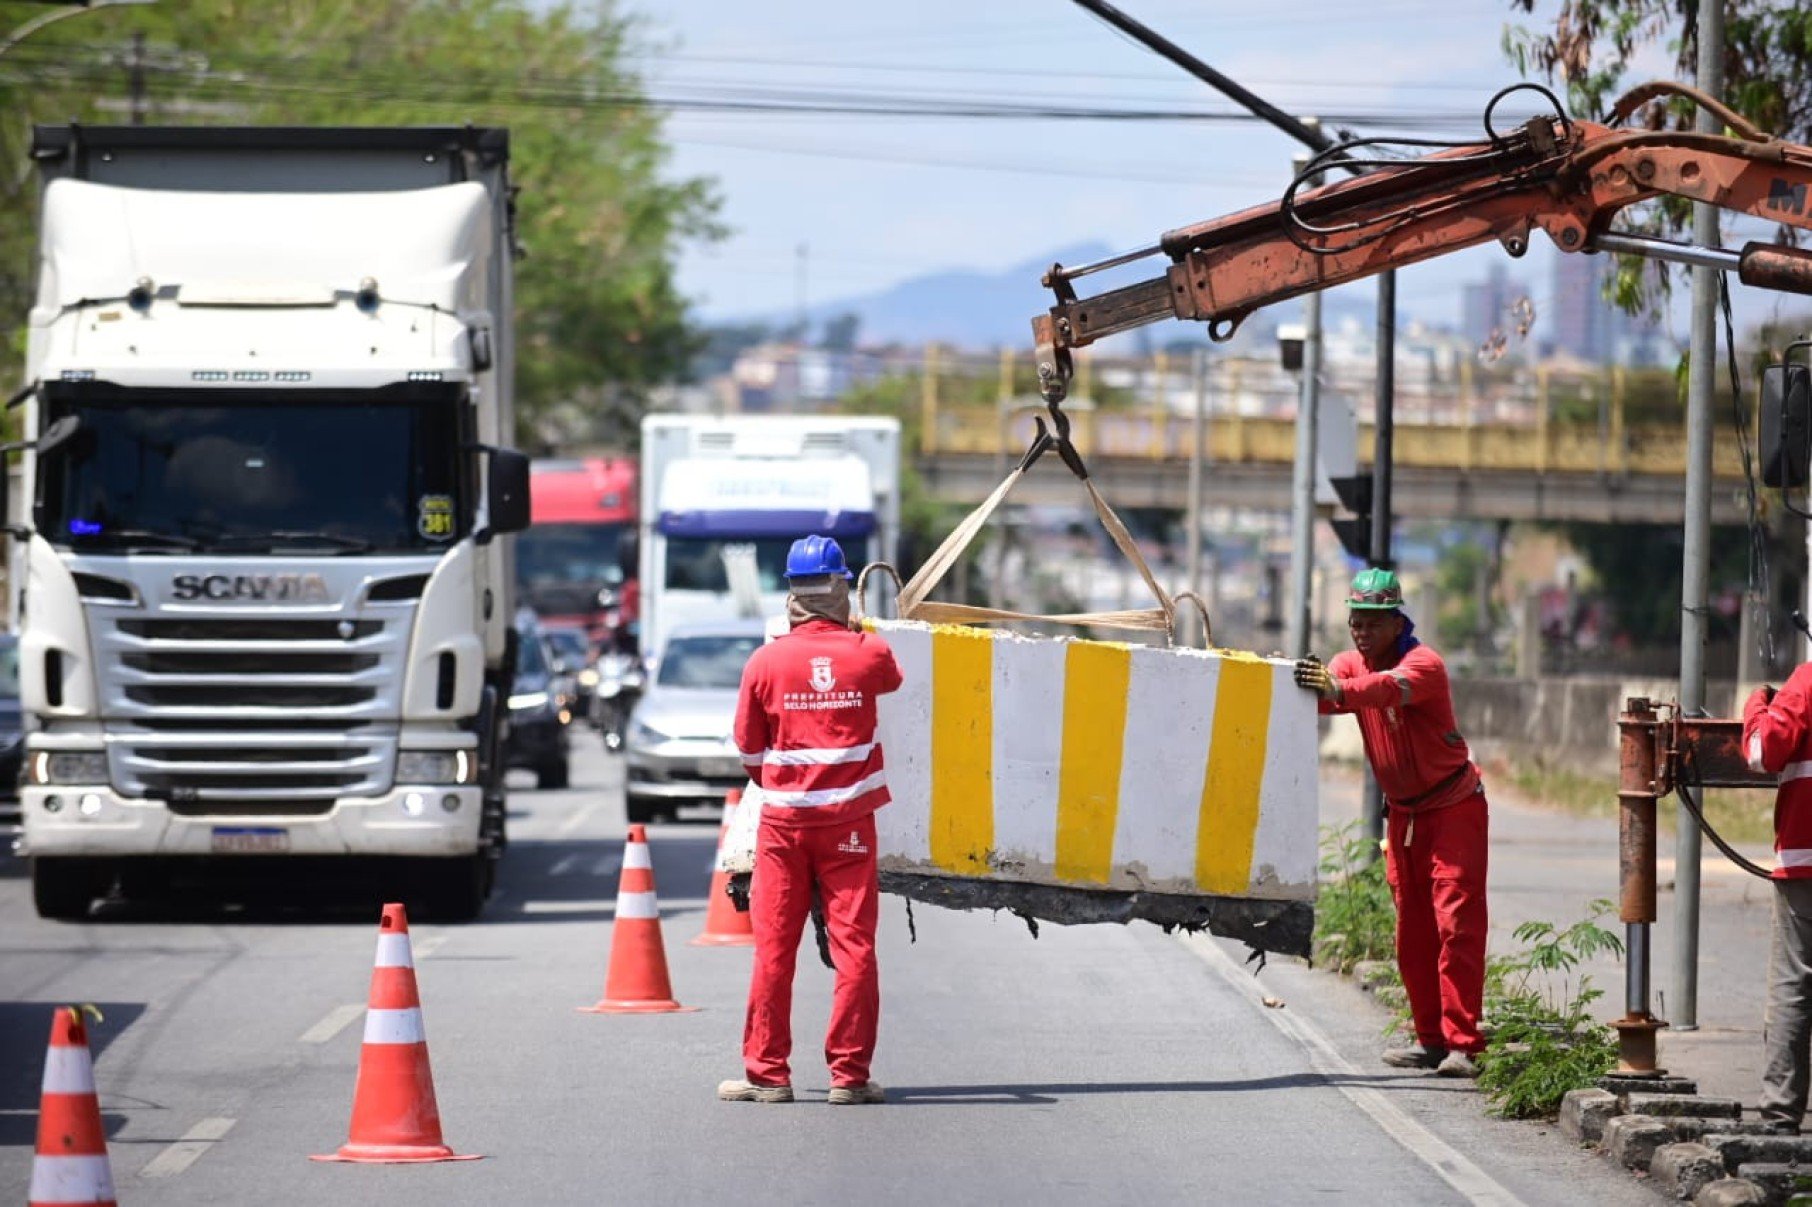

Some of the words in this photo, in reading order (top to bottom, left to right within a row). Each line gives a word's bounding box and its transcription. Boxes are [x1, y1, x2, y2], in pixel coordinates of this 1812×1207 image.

[172, 573, 330, 602] SCANIA
[783, 691, 863, 701] PREFEITURA
[783, 701, 808, 711] BELO
[809, 699, 863, 711] HORIZONTE
